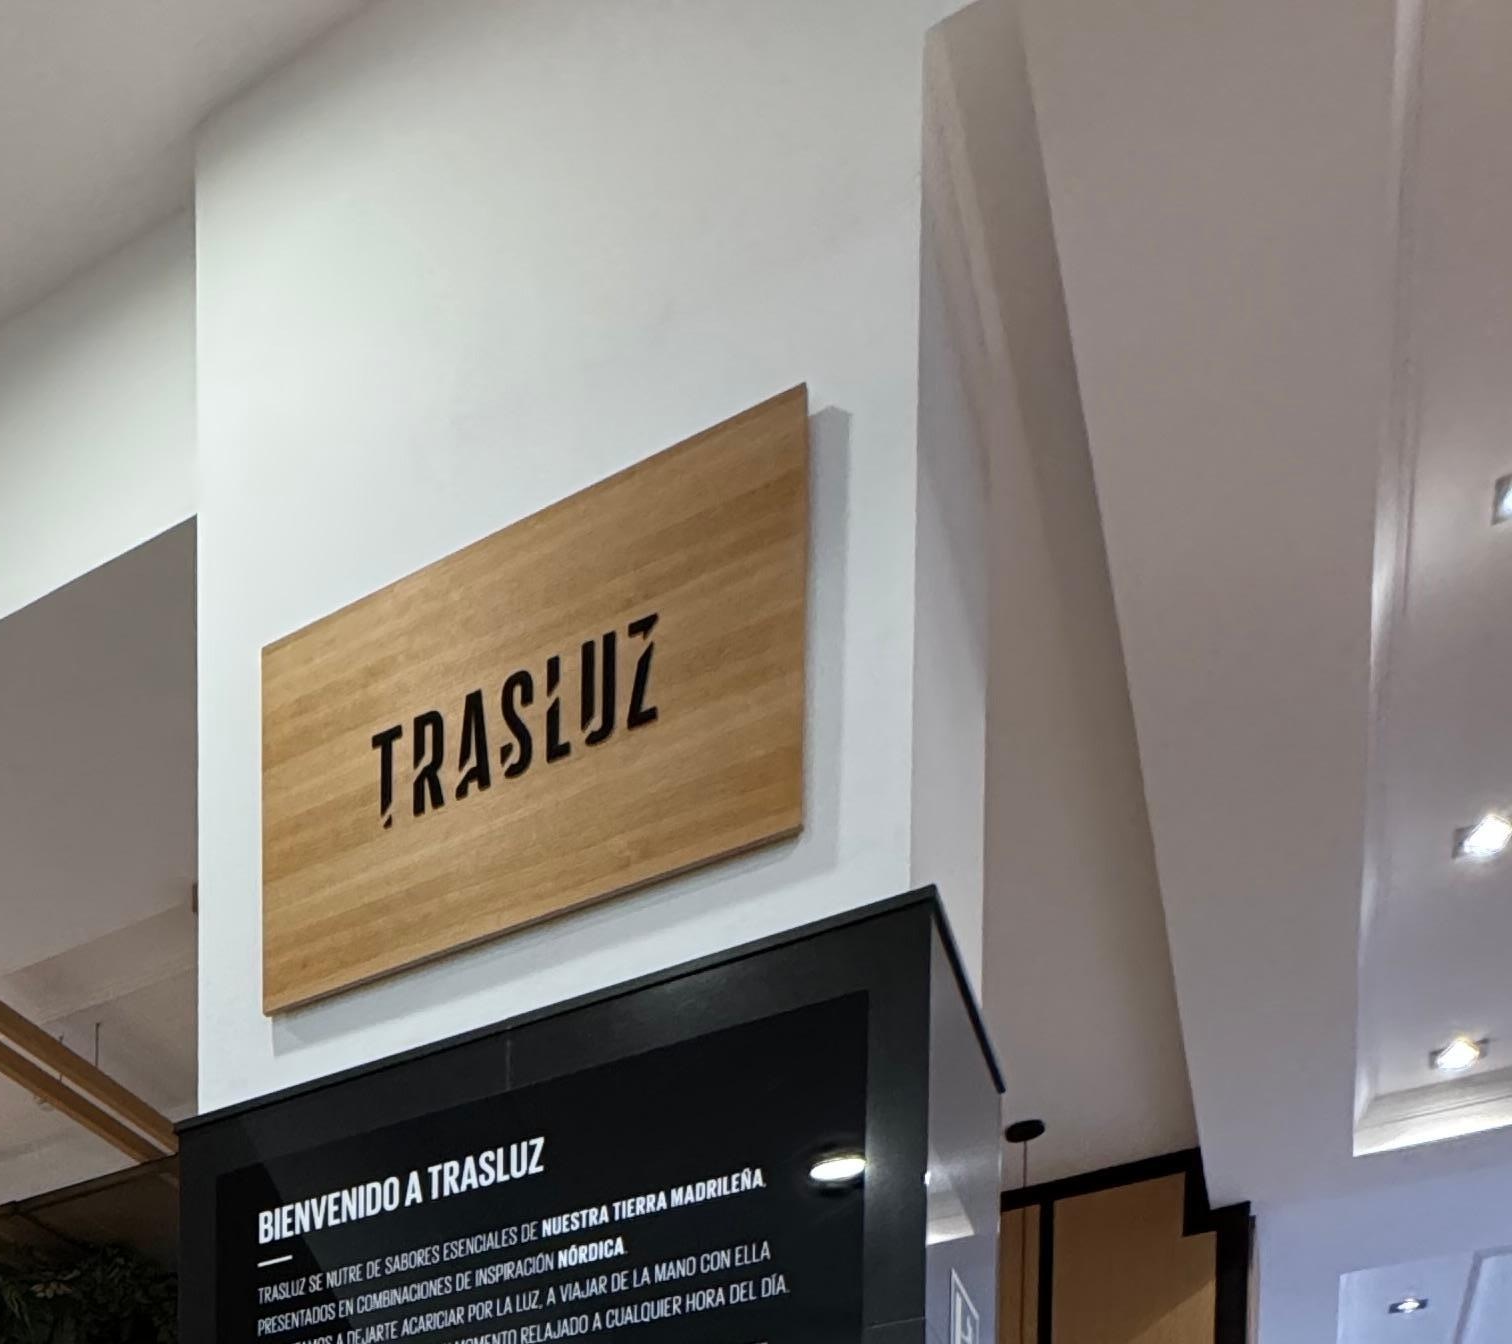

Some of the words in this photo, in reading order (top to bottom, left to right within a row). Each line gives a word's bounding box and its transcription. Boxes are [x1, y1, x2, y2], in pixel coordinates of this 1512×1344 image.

[371, 612, 659, 829] TRASLUZ
[259, 1176, 399, 1244] BIENVENIDO
[405, 1171, 422, 1207] A
[428, 1137, 544, 1200] TRASLUZ
[258, 1278, 305, 1304] TRASLUZ
[309, 1273, 323, 1293] SE
[326, 1265, 363, 1289] NUTRE
[366, 1262, 381, 1279] DE
[385, 1245, 439, 1275] SABORES
[443, 1226, 517, 1261] ESENCIALES
[522, 1221, 538, 1240] DE
[542, 1205, 609, 1237] NUESTRA
[612, 1190, 667, 1221] TIERRA
[258, 1303, 335, 1336] PRESENTADOS
[339, 1299, 353, 1318] EN
[357, 1275, 452, 1314] COMBINACIONES
[456, 1271, 470, 1292] DE
[475, 1253, 553, 1288] INSPIRACIÓN
[402, 1307, 464, 1337] ACARICIAR
[468, 1300, 492, 1323] POR
[496, 1296, 512, 1317] LA
[547, 1287, 555, 1307] A
[560, 1275, 607, 1300] VIAJAR
[611, 1270, 629, 1292] DE
[633, 1266, 650, 1288] LA
[655, 1256, 696, 1283] MANO
[700, 1249, 731, 1274] CON
[735, 1240, 771, 1267] ELLA
[593, 1312, 601, 1331] A
[606, 1295, 681, 1329] CUALQUIER
[686, 1287, 725, 1313] HORA
[730, 1281, 756, 1304] DEL
